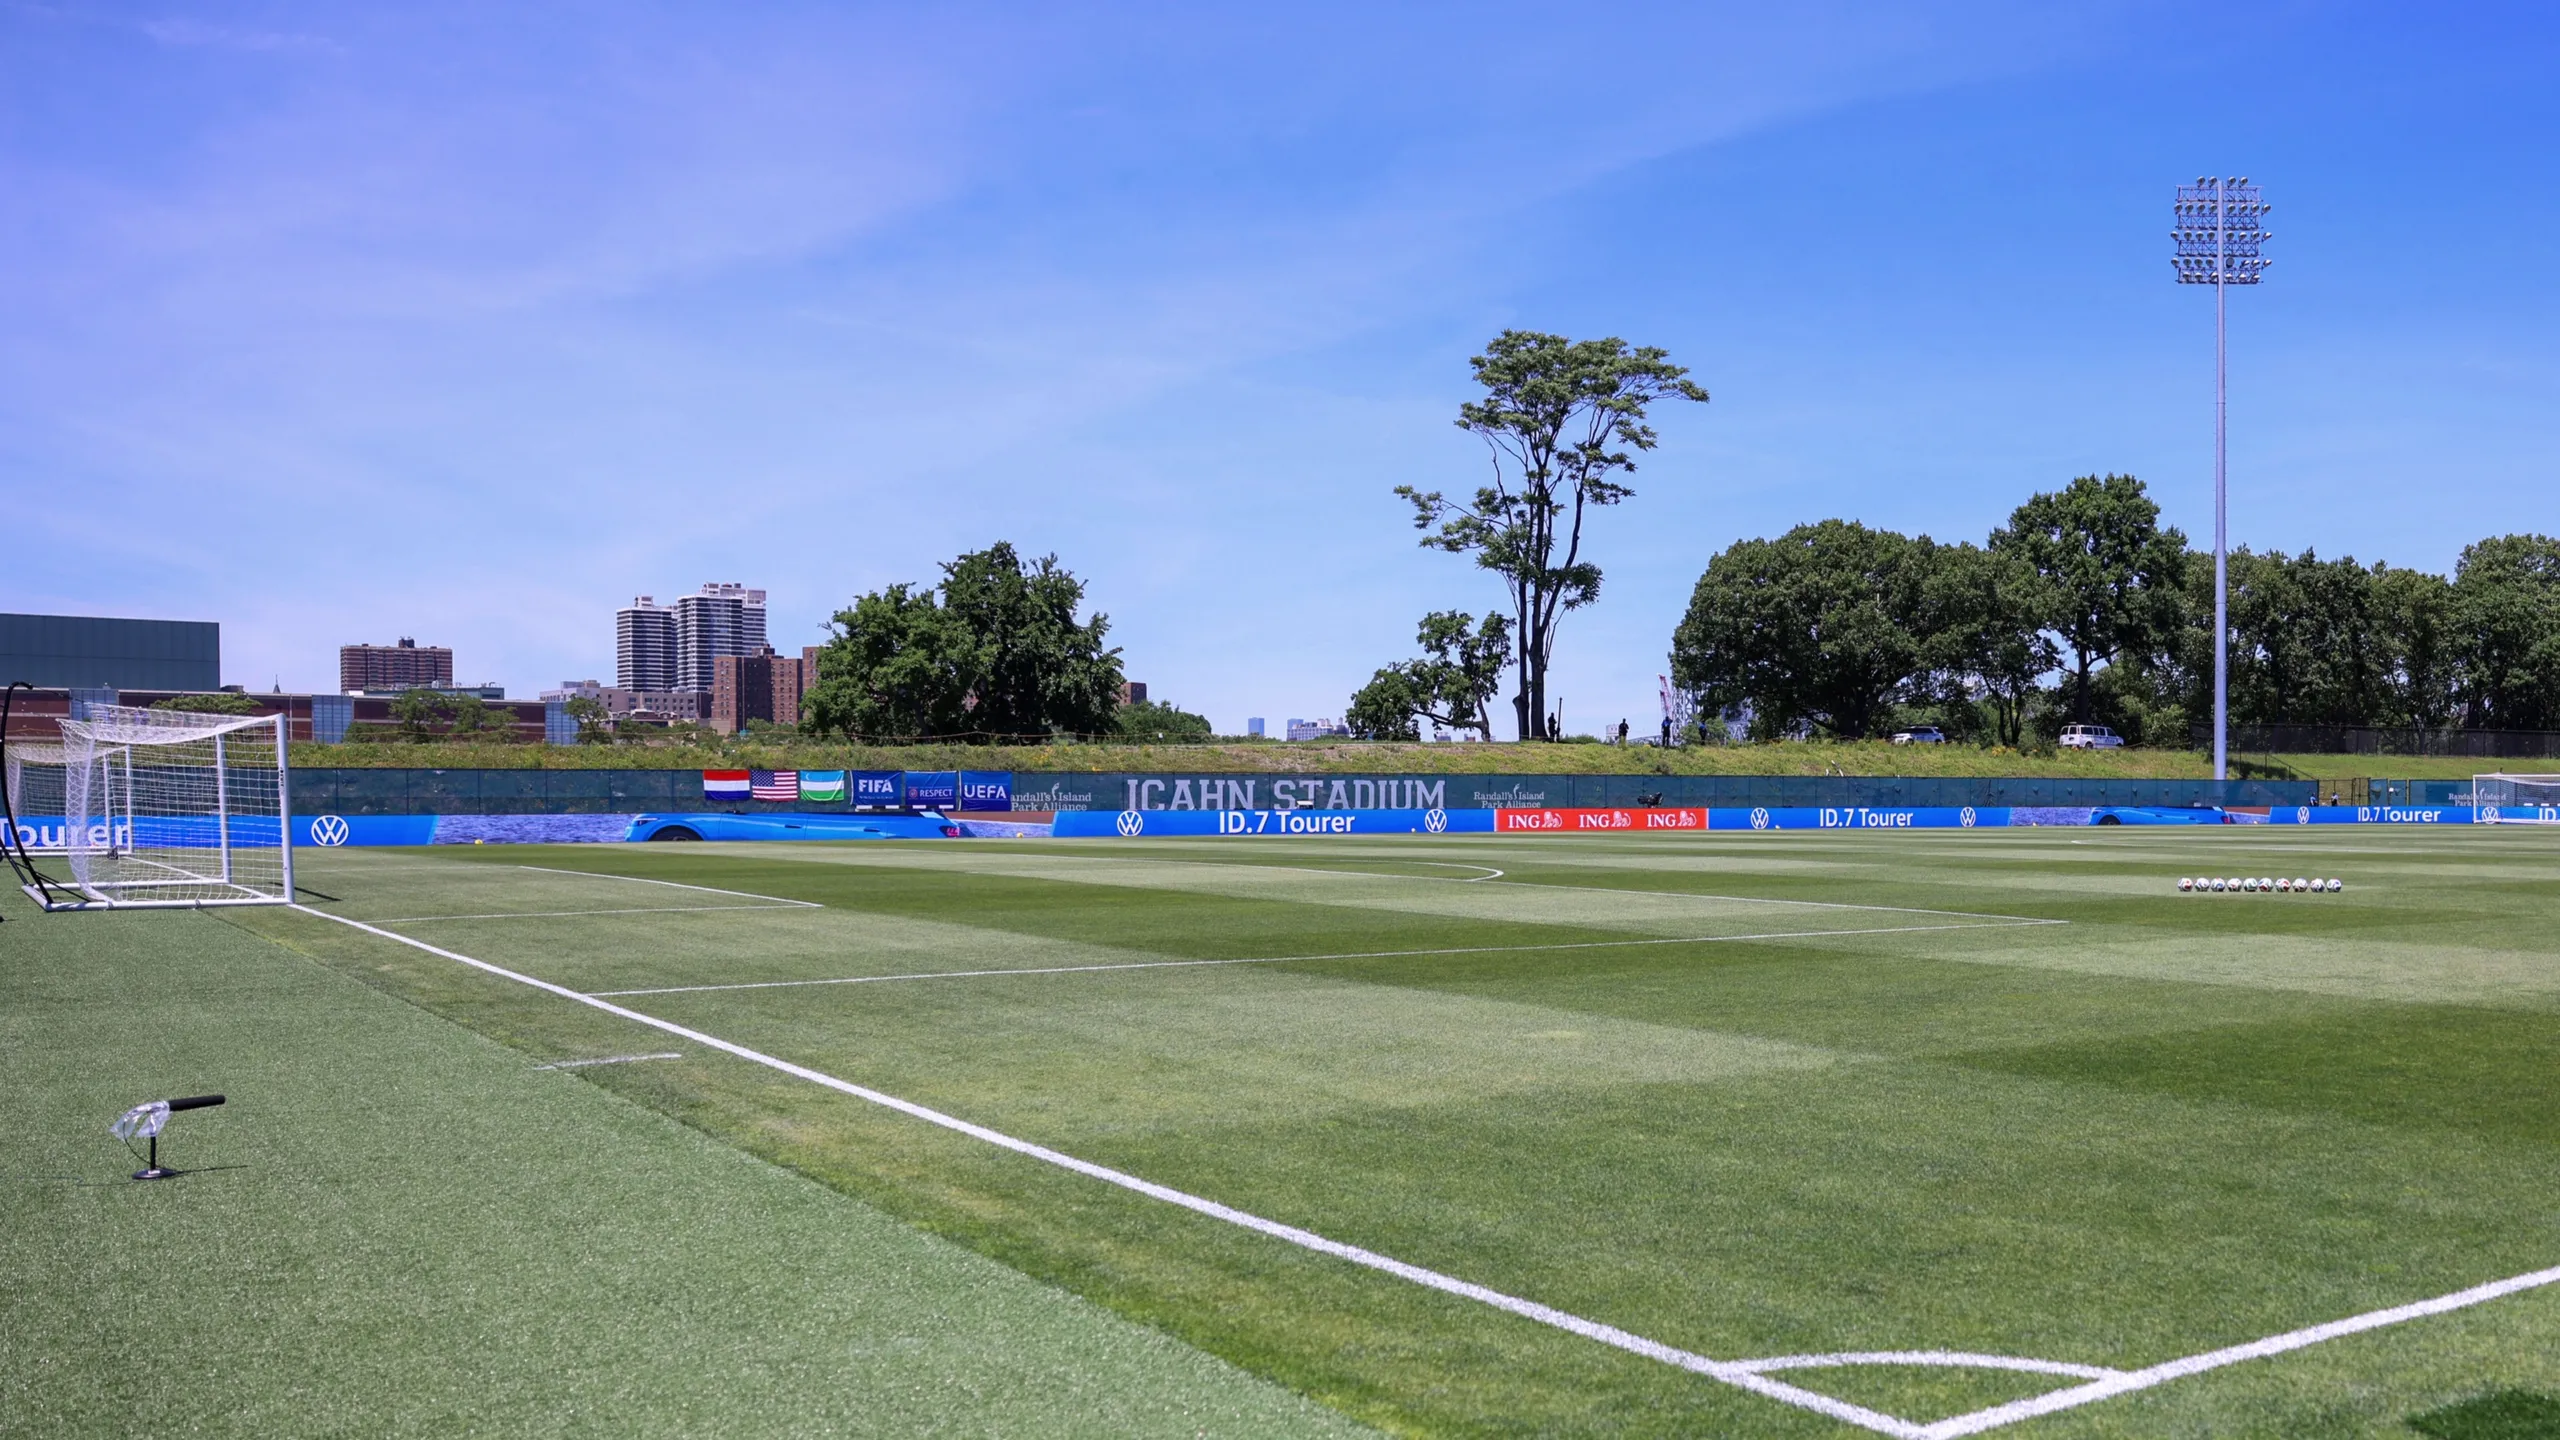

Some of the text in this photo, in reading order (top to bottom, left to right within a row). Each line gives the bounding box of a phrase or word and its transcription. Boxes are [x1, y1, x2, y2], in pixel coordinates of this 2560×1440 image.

[859, 779, 893, 792] FIFA
[964, 784, 1007, 799] UEFA
[920, 788, 953, 798] RESPECT
[1010, 792, 1092, 802] andall's Island
[1127, 779, 1446, 811] ICAHN STADIUM
[1473, 791, 1545, 801] Randall's Island
[1011, 802, 1088, 812] Park Alliance
[1481, 800, 1542, 809] Park Alliance
[1508, 813, 1676, 829] ING ING ING
[1819, 808, 1914, 828] ID.7 Tourer
[2357, 806, 2441, 822] ID.7 Tourer
[1219, 810, 1356, 834] ID.7 Tourer
